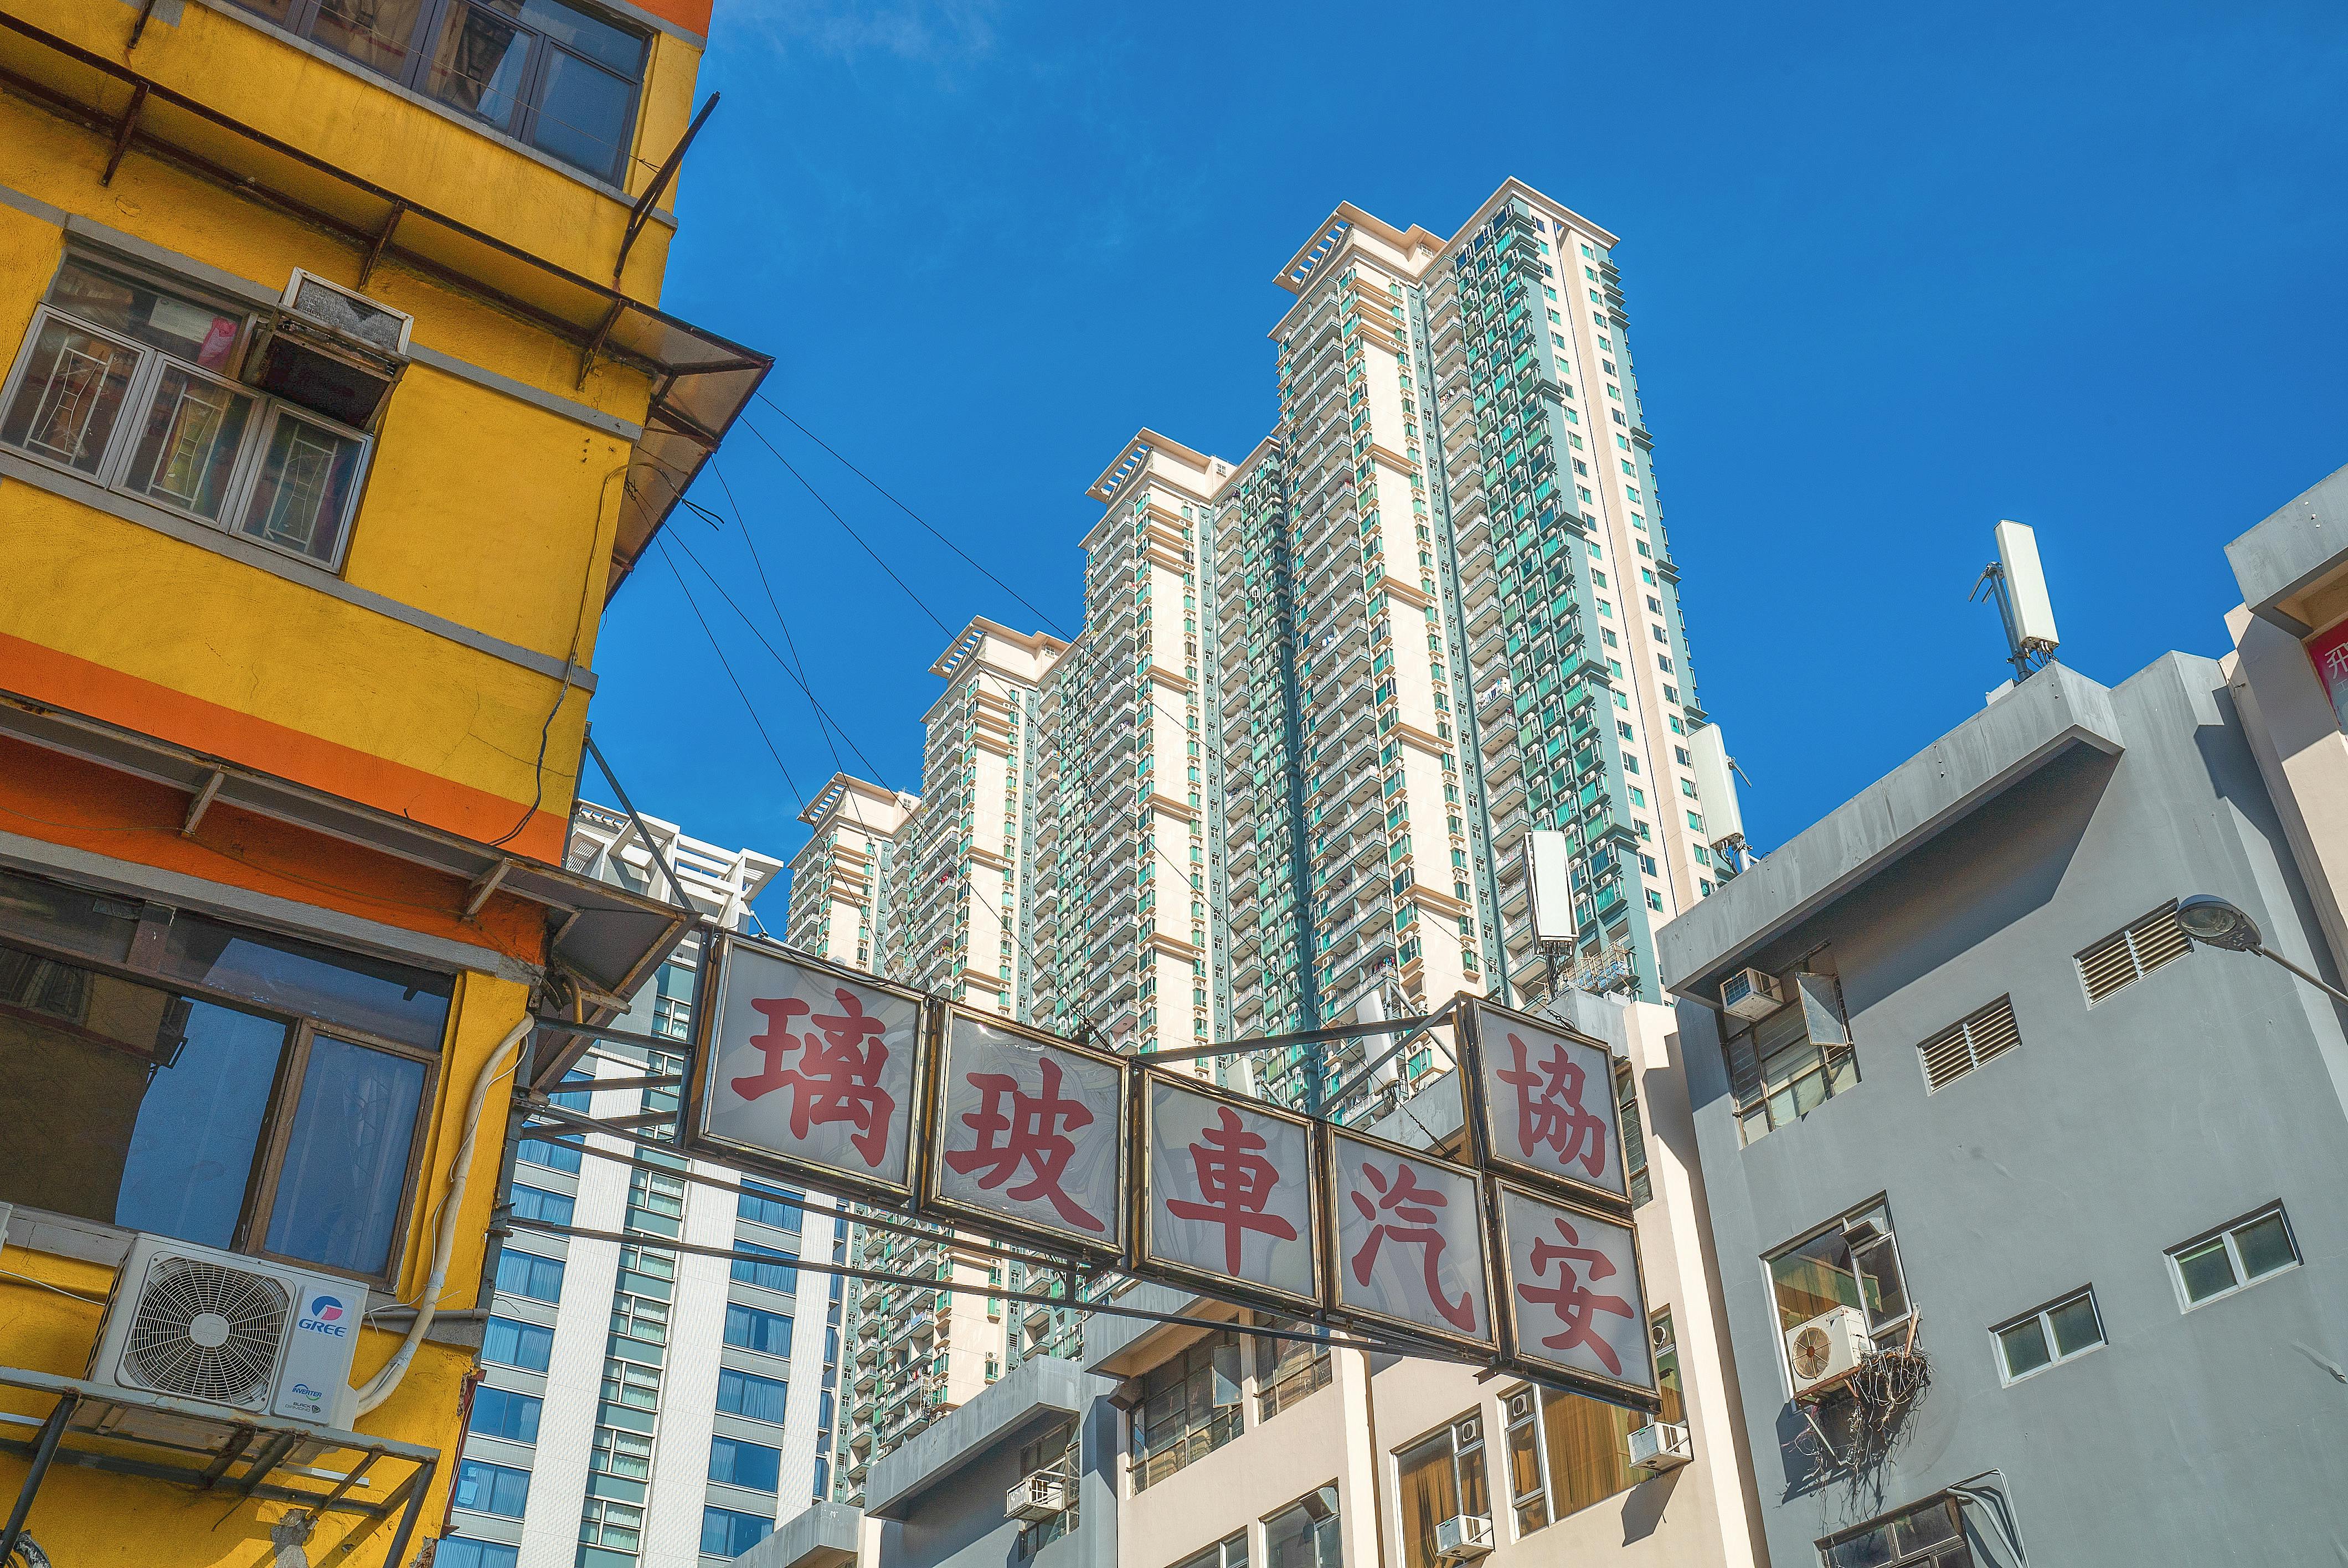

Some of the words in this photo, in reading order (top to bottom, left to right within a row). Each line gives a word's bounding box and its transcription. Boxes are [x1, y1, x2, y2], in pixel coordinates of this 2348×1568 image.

[298, 1318, 347, 1337] GREE
[292, 1387, 322, 1397] INVERTER
[285, 1404, 311, 1412] DIAMOND
